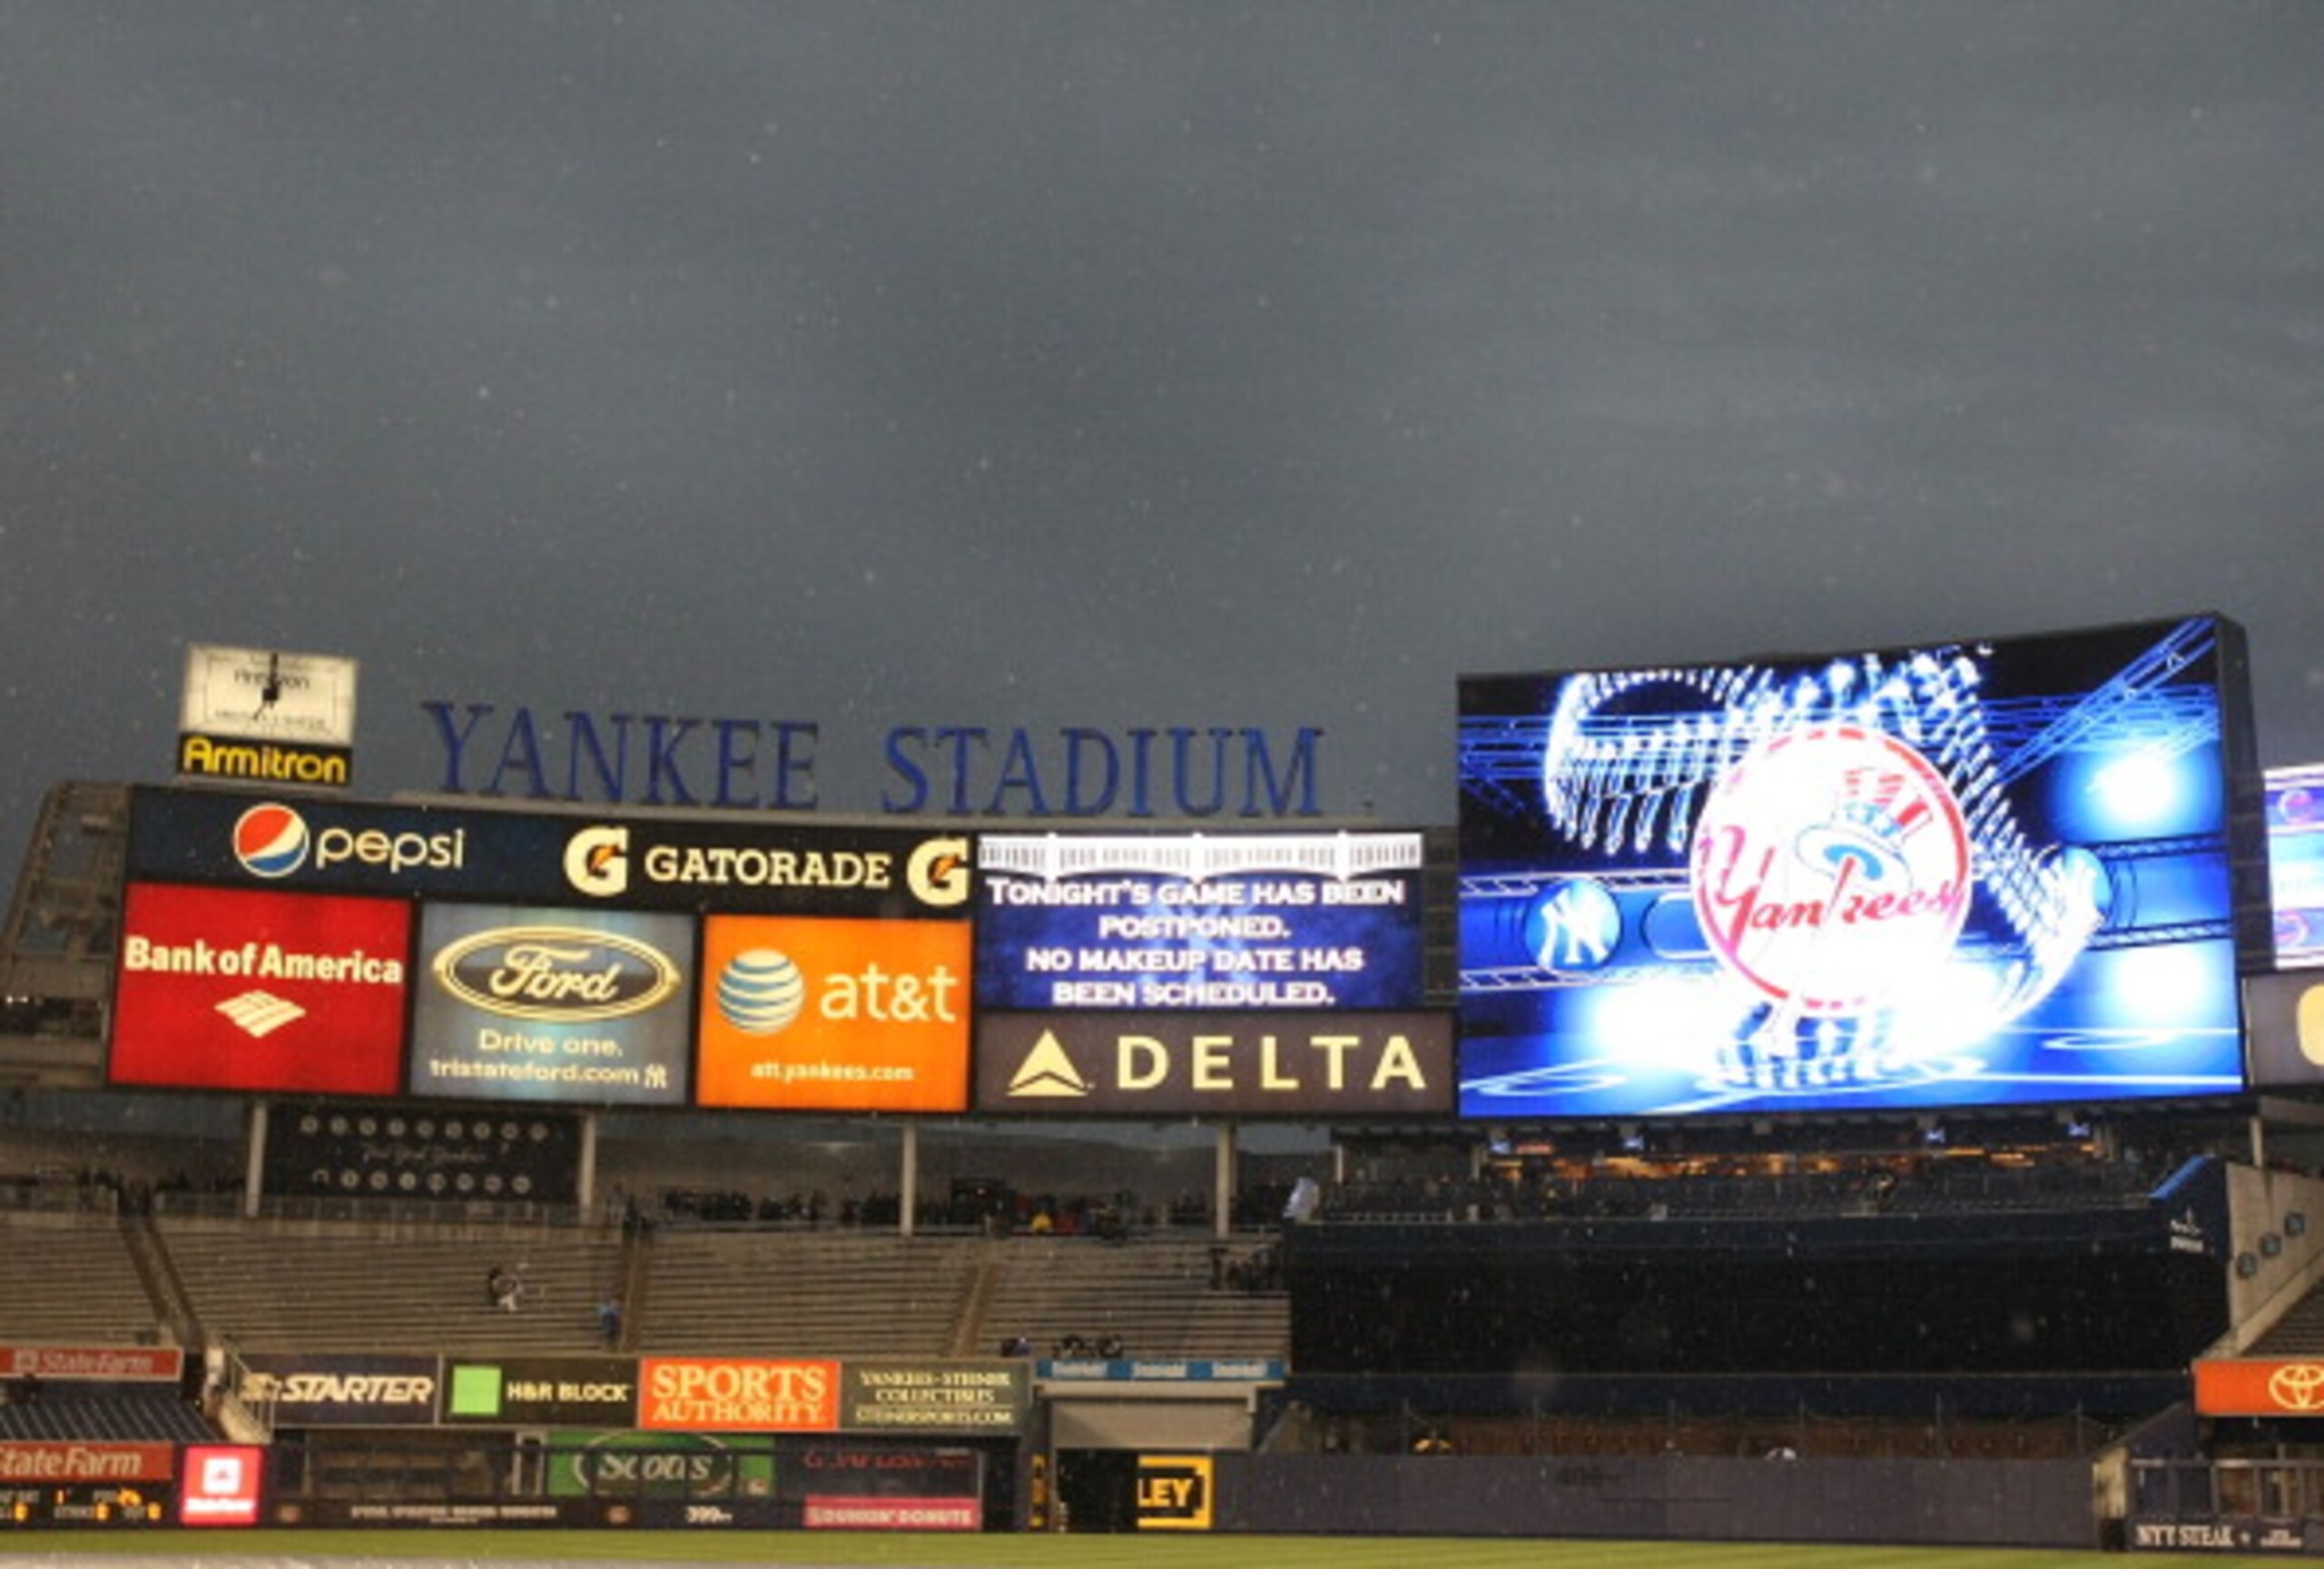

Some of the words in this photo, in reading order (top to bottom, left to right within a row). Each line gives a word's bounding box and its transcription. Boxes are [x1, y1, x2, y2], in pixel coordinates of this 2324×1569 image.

[183, 736, 347, 784] Armitron
[421, 700, 820, 807] YANKEE
[881, 725, 1324, 817] STADIUM
[316, 828, 465, 873] pepsi
[645, 846, 891, 889] GATORADE
[986, 876, 1149, 905] TONIGHT'S
[1157, 881, 1246, 905] GAME
[1251, 881, 1319, 905] HAS
[1322, 881, 1404, 905] BEEN
[1698, 824, 1966, 959] Yankees
[1098, 915, 1292, 940] POSTPONED.
[124, 935, 216, 975] Bank
[219, 942, 258, 976] of
[258, 943, 403, 984] America
[488, 942, 623, 1002] Ford
[1026, 949, 1072, 972] NO
[1078, 949, 1206, 972] MAKEUP
[1213, 949, 1295, 972] DATE
[1300, 949, 1365, 972] HAS
[819, 962, 960, 1022] at&t
[1051, 982, 1136, 1006] BEEN
[1141, 982, 1336, 1006] SCHEDULED.
[479, 1028, 556, 1054] Drive
[562, 1036, 624, 1057] one.
[429, 1059, 638, 1084] tristateford.com
[751, 1061, 913, 1081] att.yankees.com
[1118, 1035, 1425, 1090] DELTA
[281, 1375, 435, 1404] STARTER
[506, 1383, 553, 1402] H&R
[557, 1383, 628, 1402] BLOCK
[651, 1364, 827, 1402] SPORTS
[2136, 1525, 2176, 1546] NYY
[2179, 1525, 2235, 1546] STEAK
